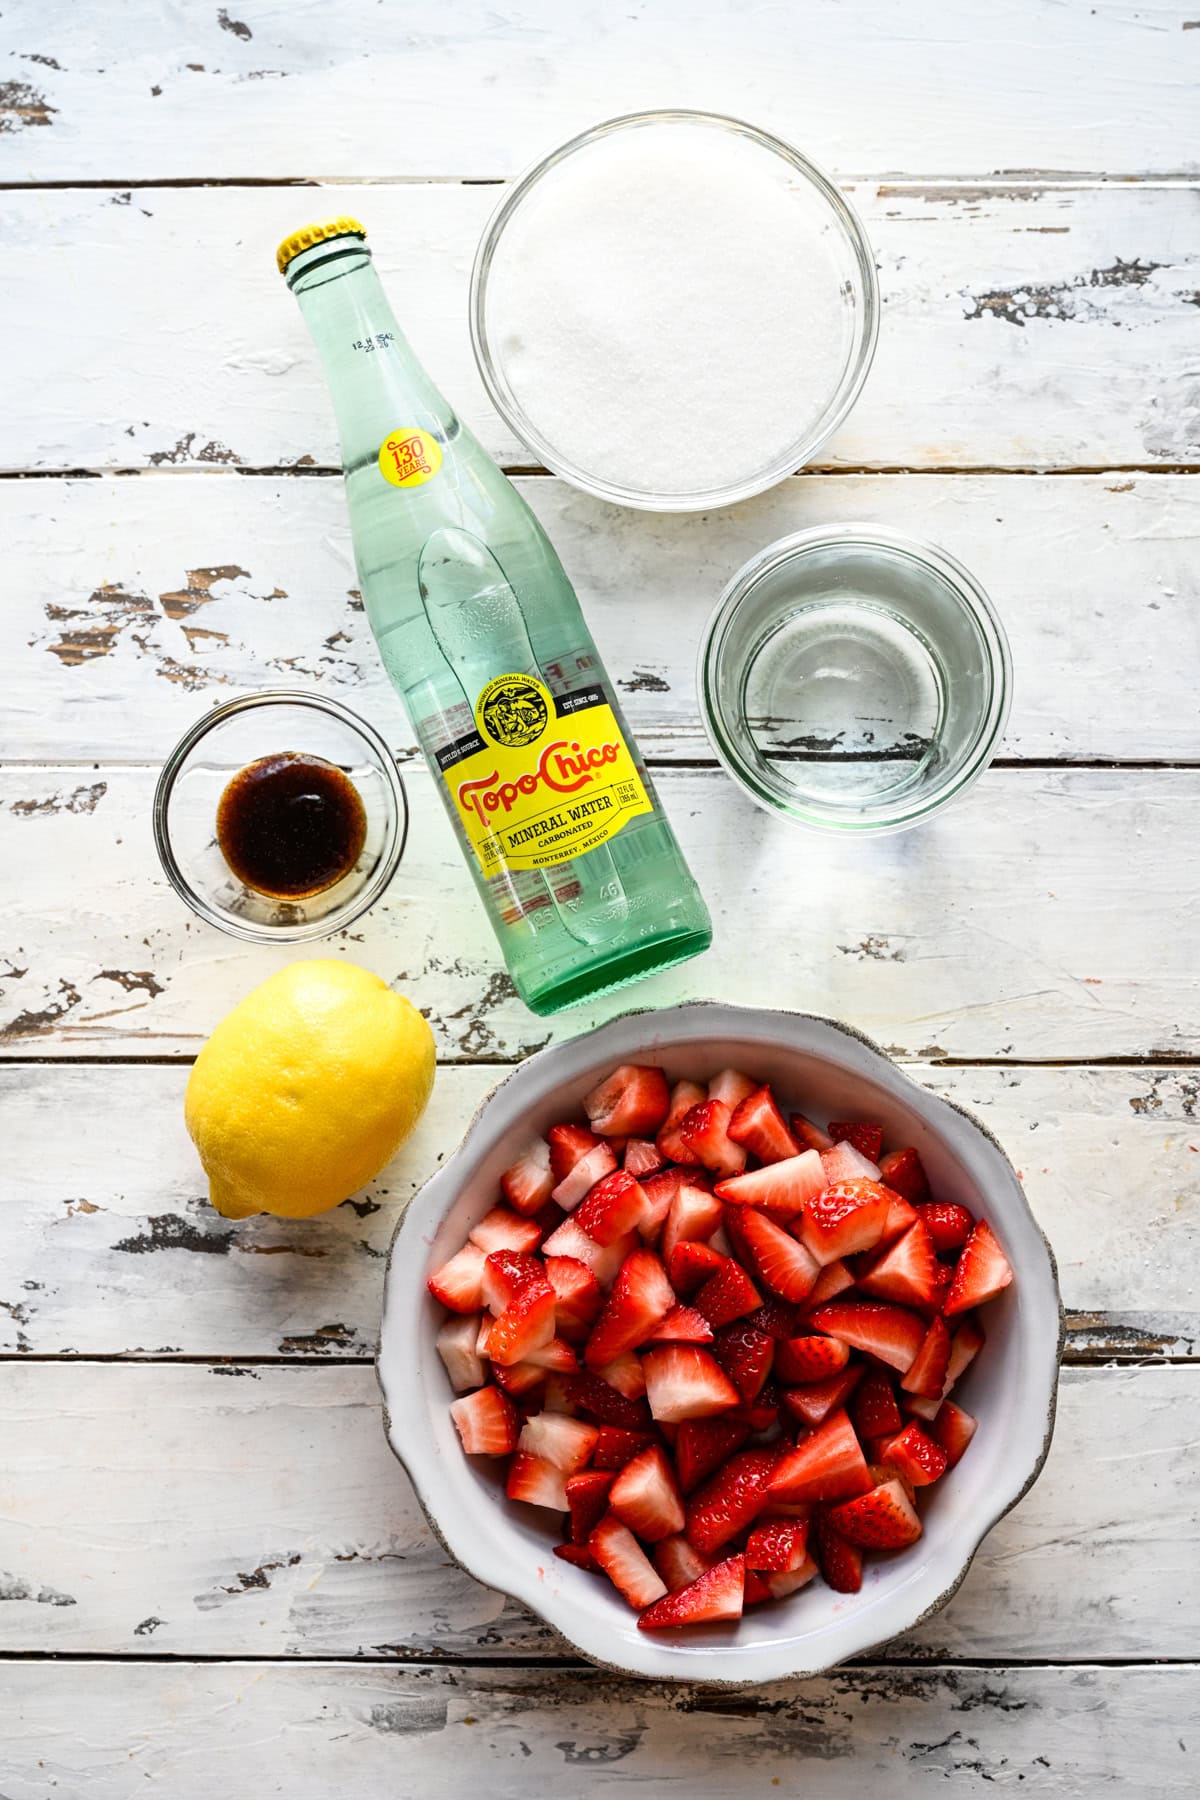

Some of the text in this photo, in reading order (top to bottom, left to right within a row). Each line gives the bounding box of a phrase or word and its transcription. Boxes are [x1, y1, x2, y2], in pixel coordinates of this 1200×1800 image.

[392, 439, 424, 469] 130
[396, 456, 426, 477] YEARS
[493, 675, 520, 687] MINERAL
[521, 676, 541, 690] WATER
[460, 738, 481, 754] SOURCE
[458, 741, 620, 828] Topo Chico
[507, 795, 614, 848] MINERAL WATER
[538, 820, 594, 848] CARBONATED
